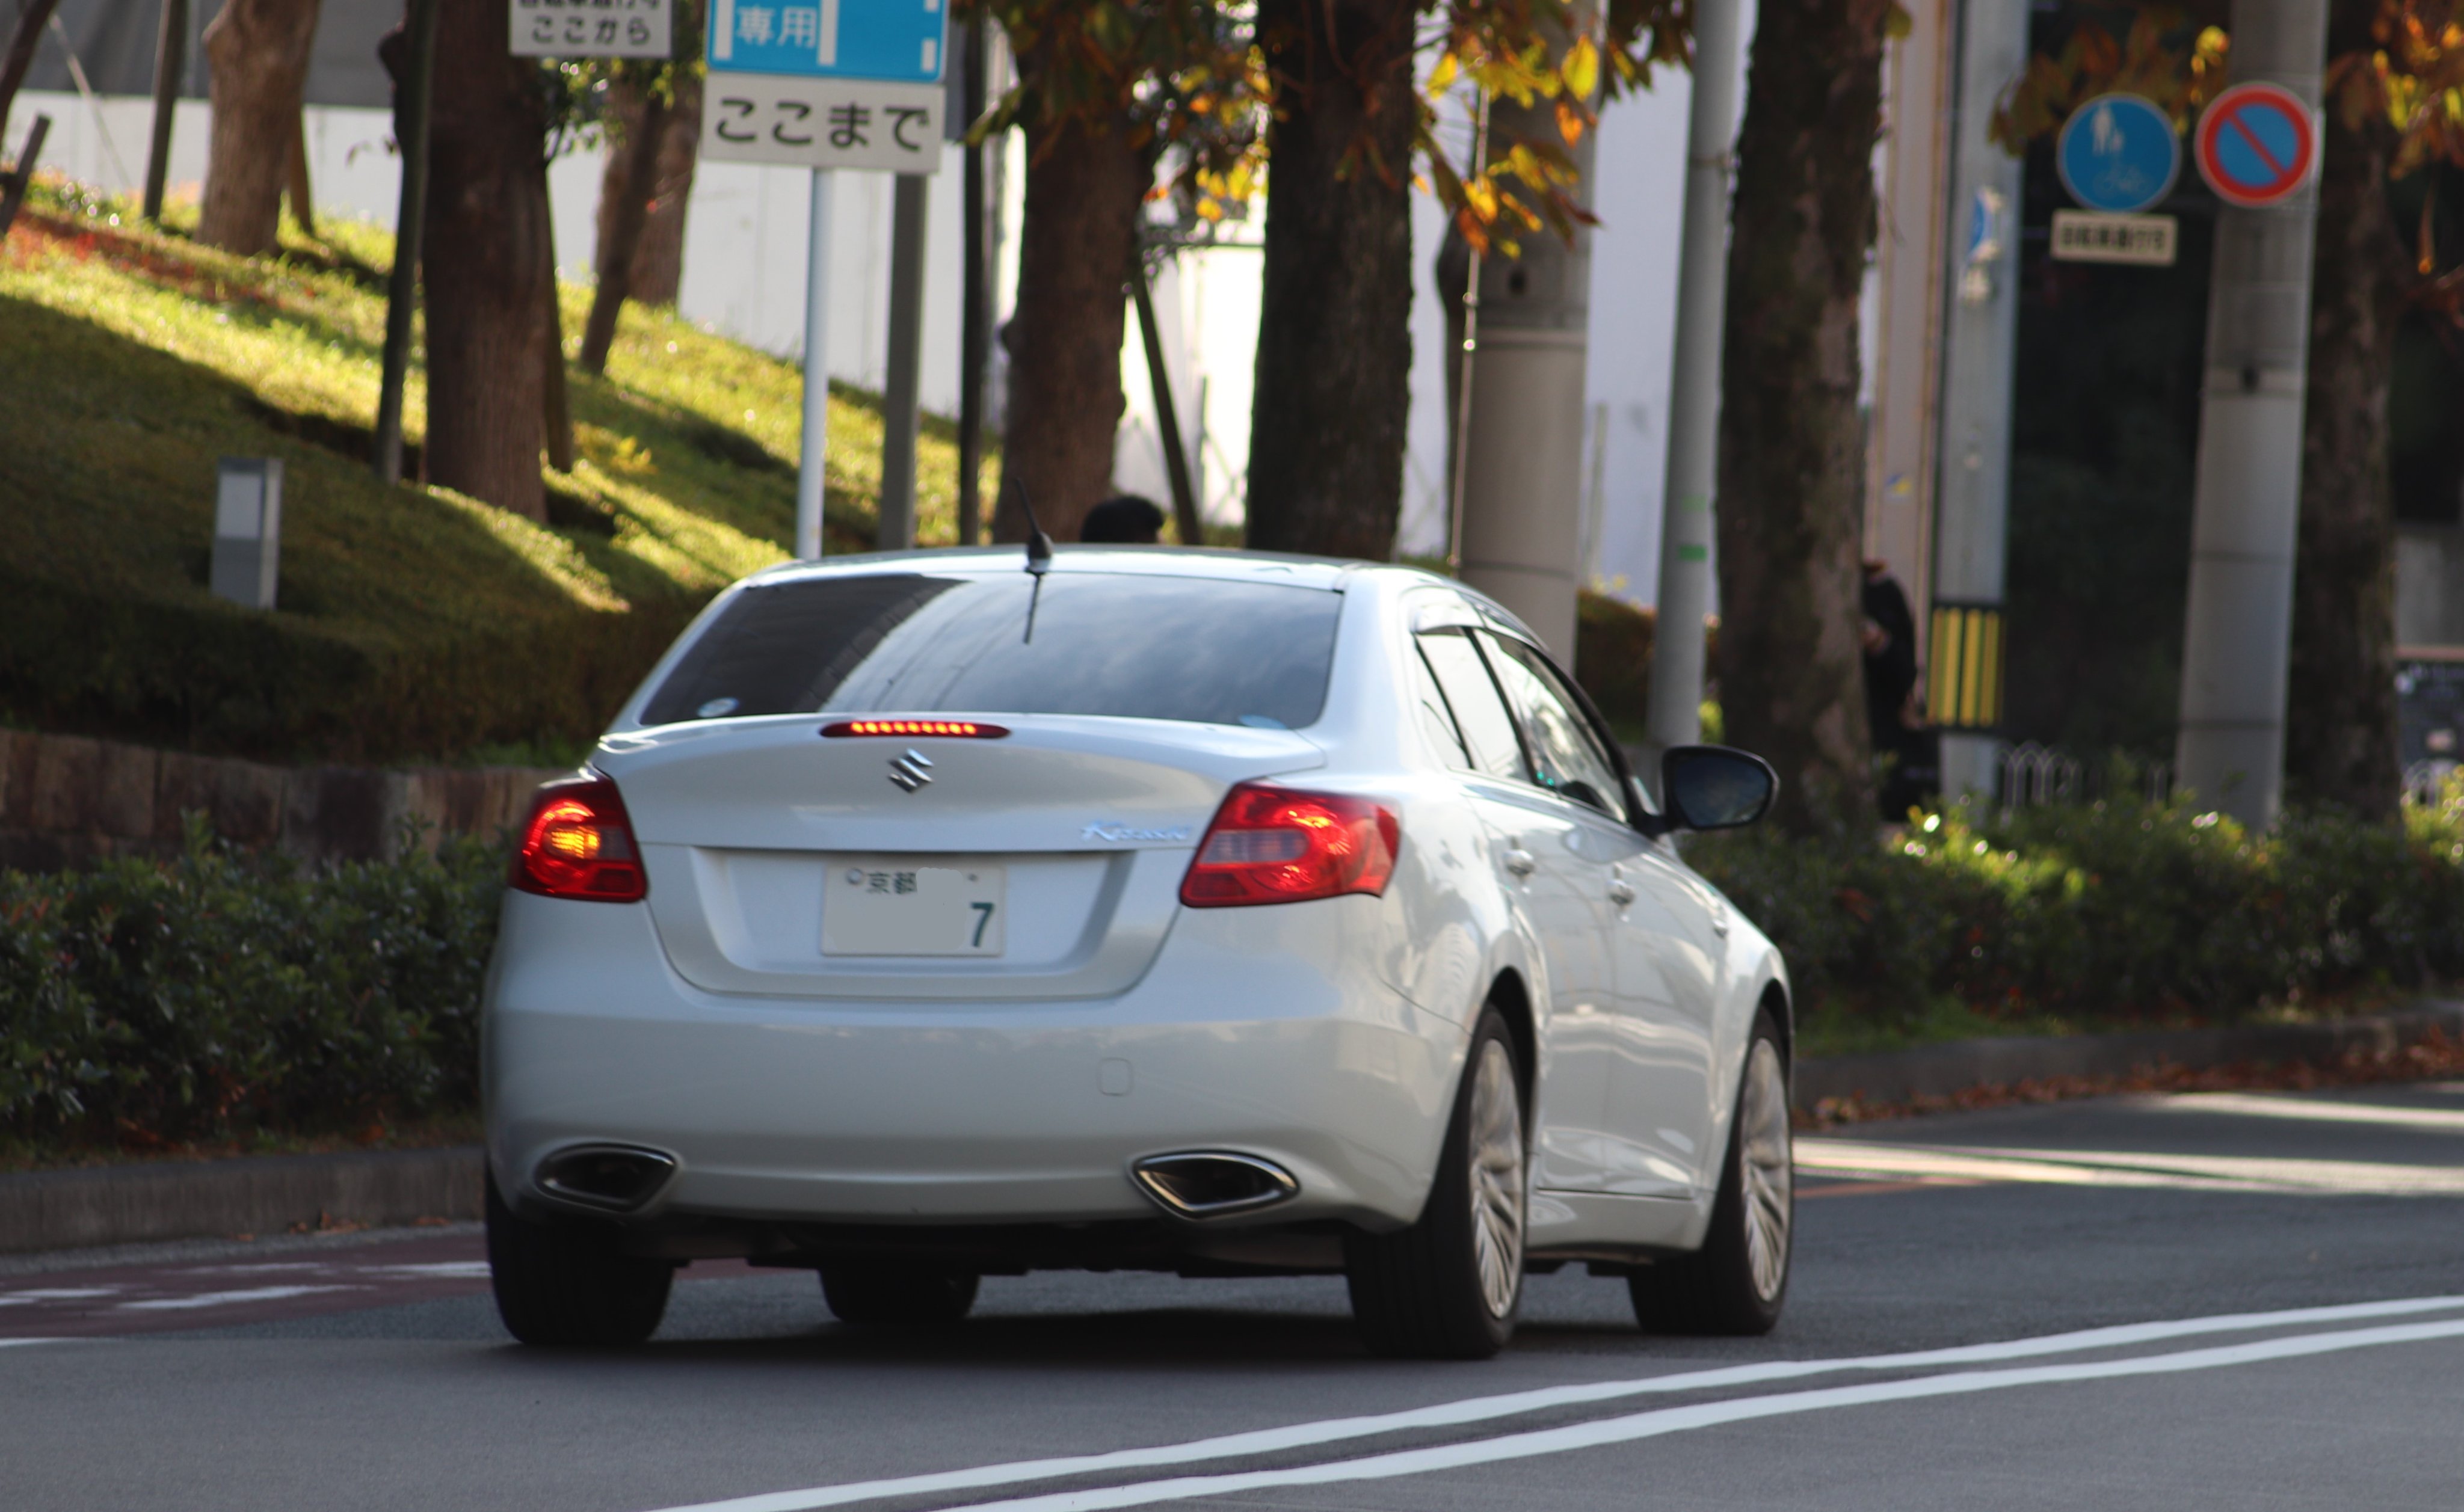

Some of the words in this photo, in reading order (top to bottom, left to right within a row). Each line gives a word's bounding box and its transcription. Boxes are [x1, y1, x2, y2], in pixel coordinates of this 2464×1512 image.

[532, 15, 651, 46] ここから
[737, 7, 817, 47] 専用
[715, 97, 929, 152] ここまで
[866, 871, 917, 894] 京都
